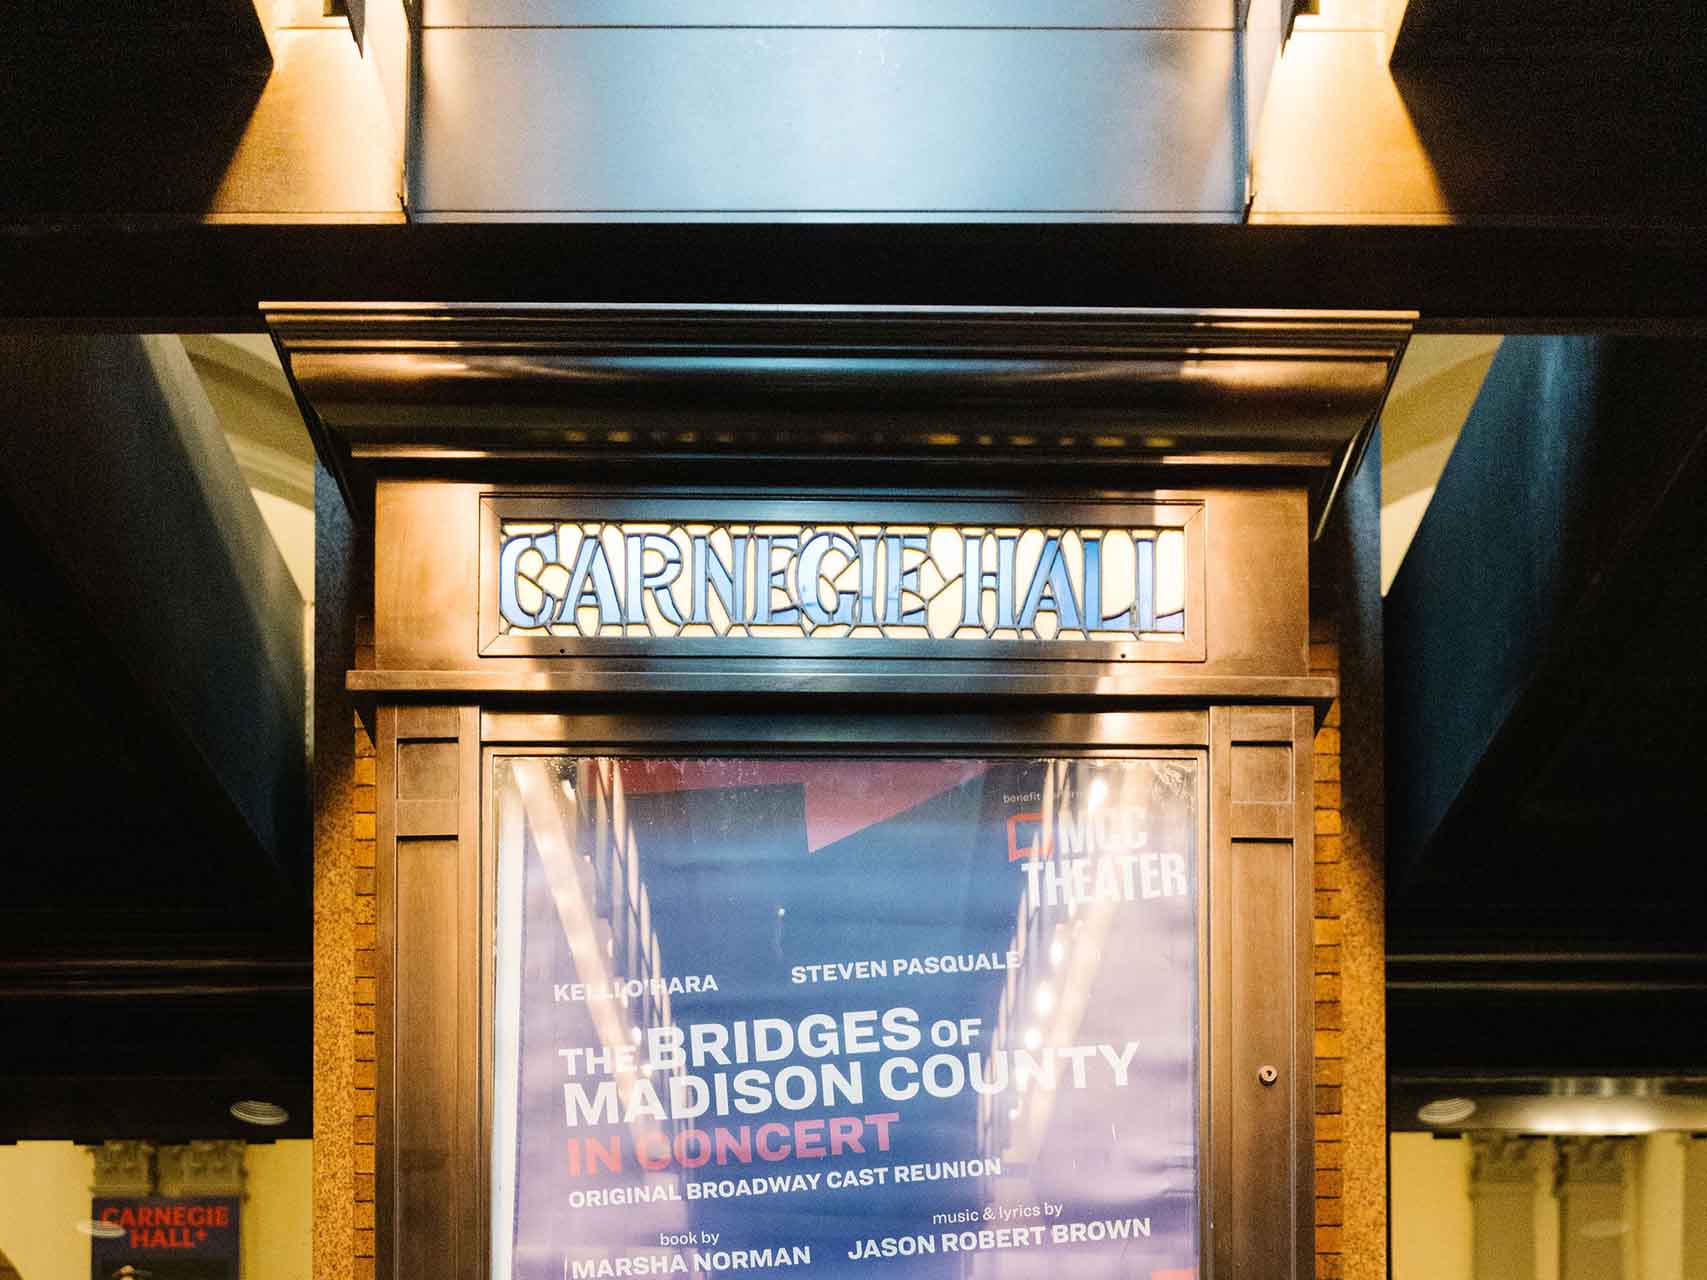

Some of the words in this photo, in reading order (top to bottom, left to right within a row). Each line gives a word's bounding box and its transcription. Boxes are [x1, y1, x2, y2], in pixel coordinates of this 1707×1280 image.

[500, 531, 930, 629] CARNEGIE
[962, 536, 1185, 632] HALL
[1021, 852, 1188, 907] THEATER
[627, 975, 719, 998] O'HARA
[791, 959, 888, 984] STEVEN
[892, 951, 1021, 977] PASQUALE
[558, 1045, 637, 1076] THE
[647, 1007, 920, 1071] BRIDGES
[931, 1018, 982, 1047] OF
[563, 1060, 865, 1128] MADISON
[878, 1041, 1140, 1100] COUNTY
[566, 1134, 622, 1178] IN
[634, 1113, 901, 1172] CONCERT
[567, 1182, 682, 1210] ORIGINAL
[686, 1172, 821, 1200] BROADWAY
[827, 1167, 888, 1190] CAST
[893, 1158, 1002, 1184] REUNION
[101, 1204, 230, 1227] CARNEGIE
[933, 1209, 979, 1225] music
[982, 1207, 996, 1220] &
[999, 1204, 1040, 1222] lyrics
[1044, 1202, 1063, 1217] by
[660, 1231, 697, 1247] book
[701, 1231, 720, 1246] by
[848, 1235, 935, 1260] JASON
[942, 1226, 1046, 1252] ROBERT
[1052, 1218, 1151, 1244] BROWN
[571, 1255, 688, 1279] MARSHA
[694, 1246, 811, 1272] NORMAN
